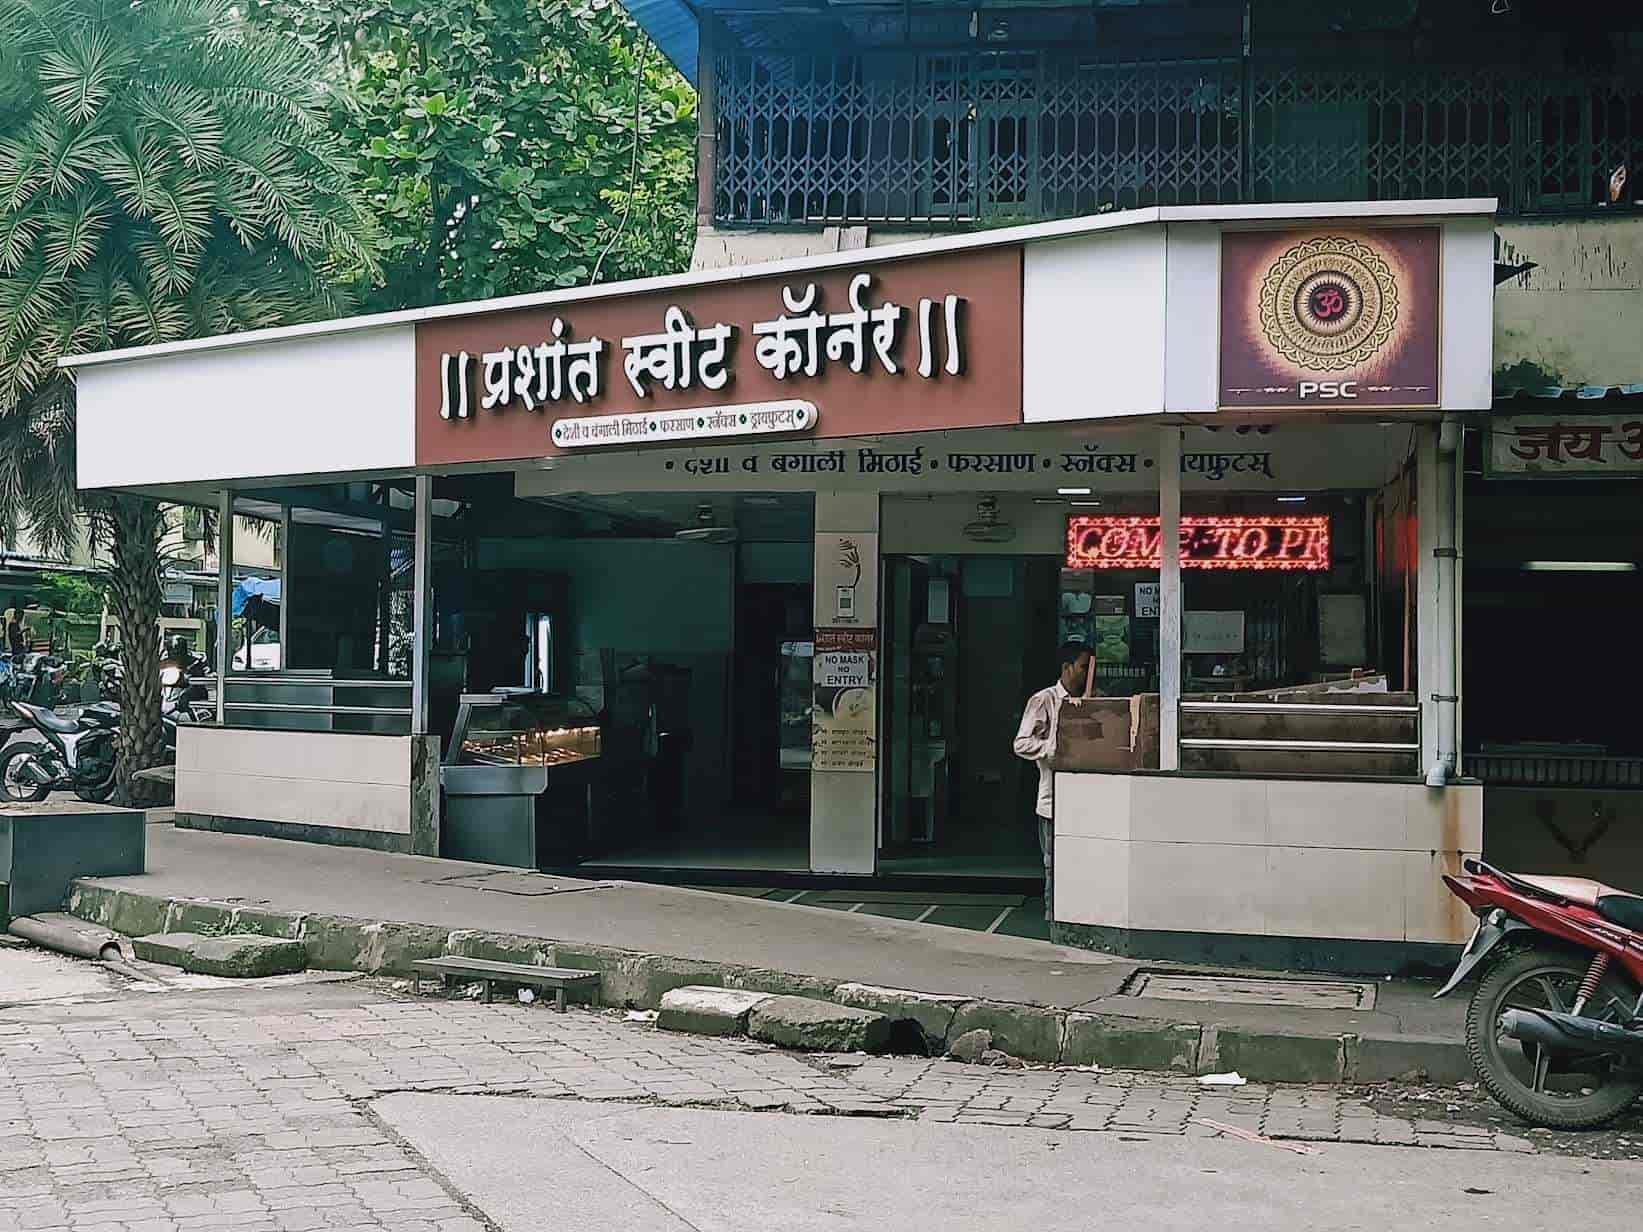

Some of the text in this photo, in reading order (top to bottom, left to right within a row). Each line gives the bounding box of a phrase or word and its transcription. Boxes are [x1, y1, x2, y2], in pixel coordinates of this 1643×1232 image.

[480, 317, 603, 409] प्रशांत
[621, 306, 731, 397] स्वीट
[753, 273, 901, 379] कॉर्नर
[1299, 382, 1359, 399] PSC
[621, 416, 648, 437] मिठाई
[659, 416, 695, 433] फरसाण
[1510, 422, 1612, 465] जय
[742, 454, 759, 474] व
[857, 447, 925, 475] मिठाई
[947, 453, 1037, 474] फरसाण
[1213, 526, 1269, 559] TO
[825, 655, 865, 665] NO MASK
[826, 674, 864, 685] ENTRY
